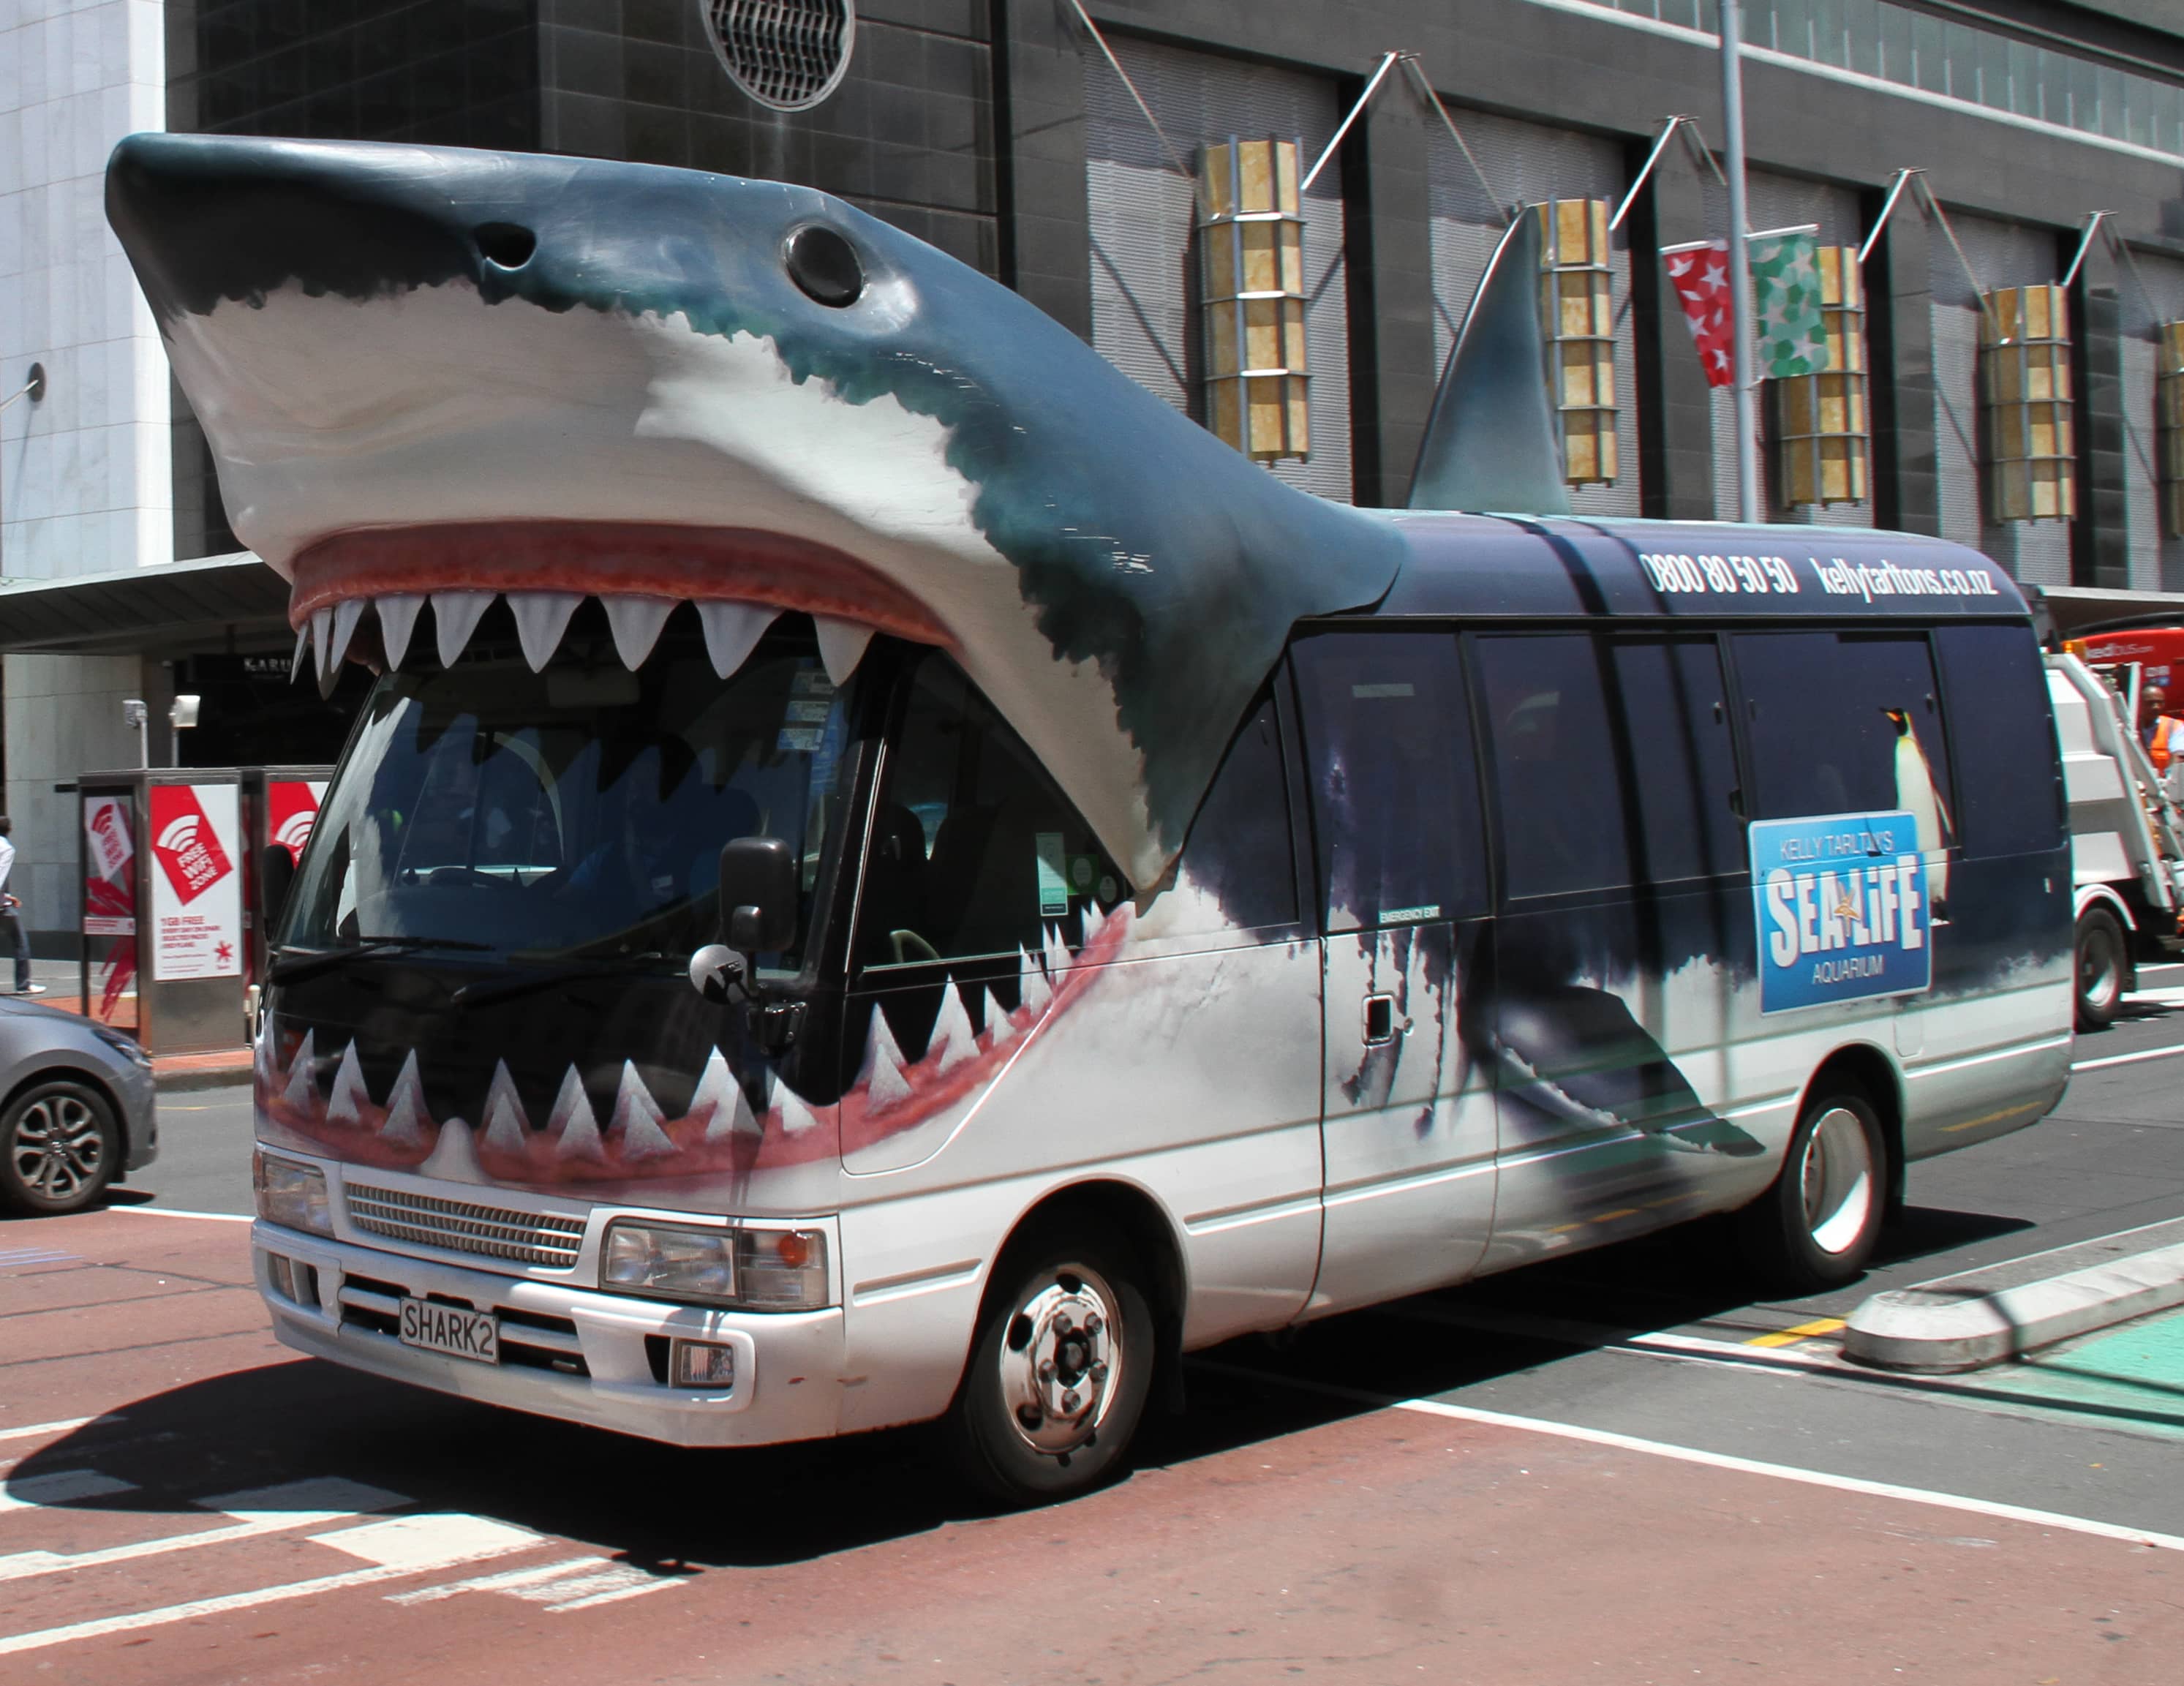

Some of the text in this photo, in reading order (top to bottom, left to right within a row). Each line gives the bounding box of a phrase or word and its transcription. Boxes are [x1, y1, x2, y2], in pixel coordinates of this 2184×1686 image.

[1639, 554, 1801, 594] 0800 80 50 50
[1808, 557, 2001, 603] kellytarltons.co.nz
[177, 842, 208, 868] FREE
[1780, 838, 1822, 861] KELLY
[188, 865, 219, 891] ZONE
[1379, 906, 1440, 923] EMERGENCY EXIT
[1767, 868, 1846, 967] SEA
[1812, 955, 1885, 985] AQUARIUM
[404, 1304, 494, 1356] SHARK2
